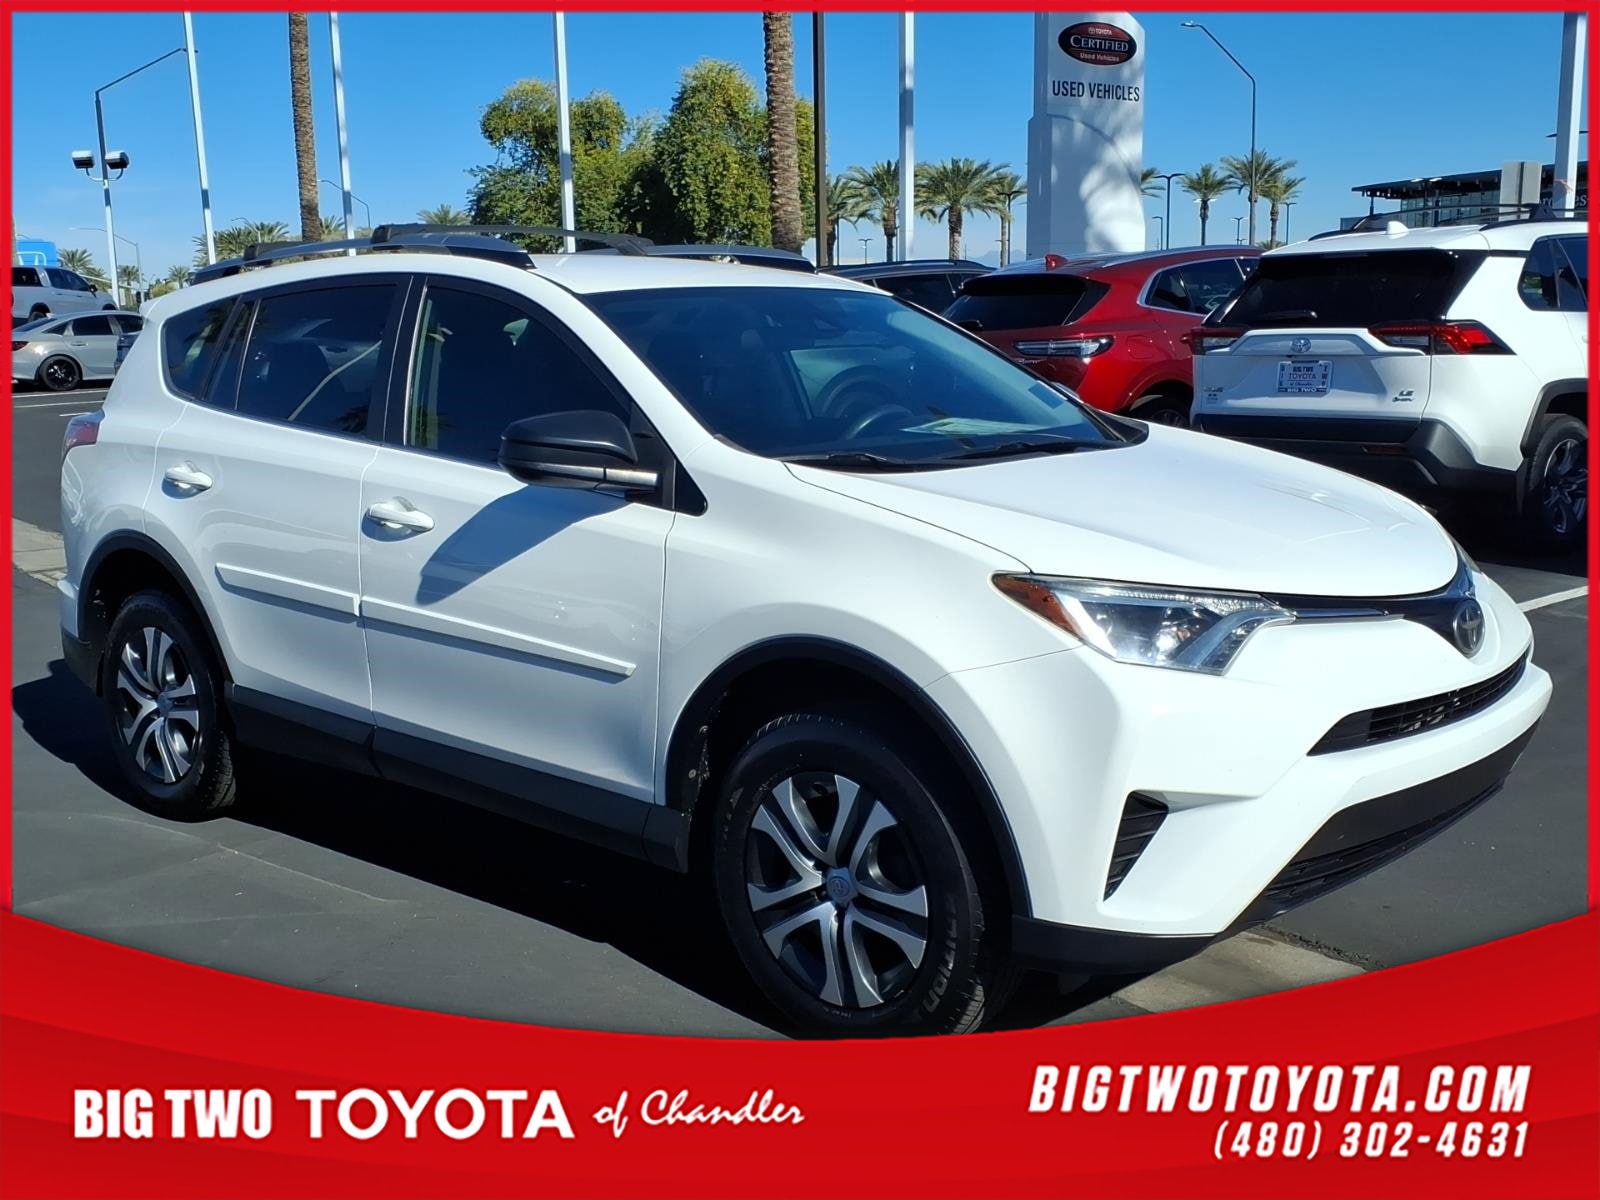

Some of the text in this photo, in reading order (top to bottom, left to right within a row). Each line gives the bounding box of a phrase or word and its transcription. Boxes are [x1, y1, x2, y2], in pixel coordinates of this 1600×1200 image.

[1052, 80, 1140, 102] USED VEHICLES
[1289, 372, 1317, 380] TOYOTA
